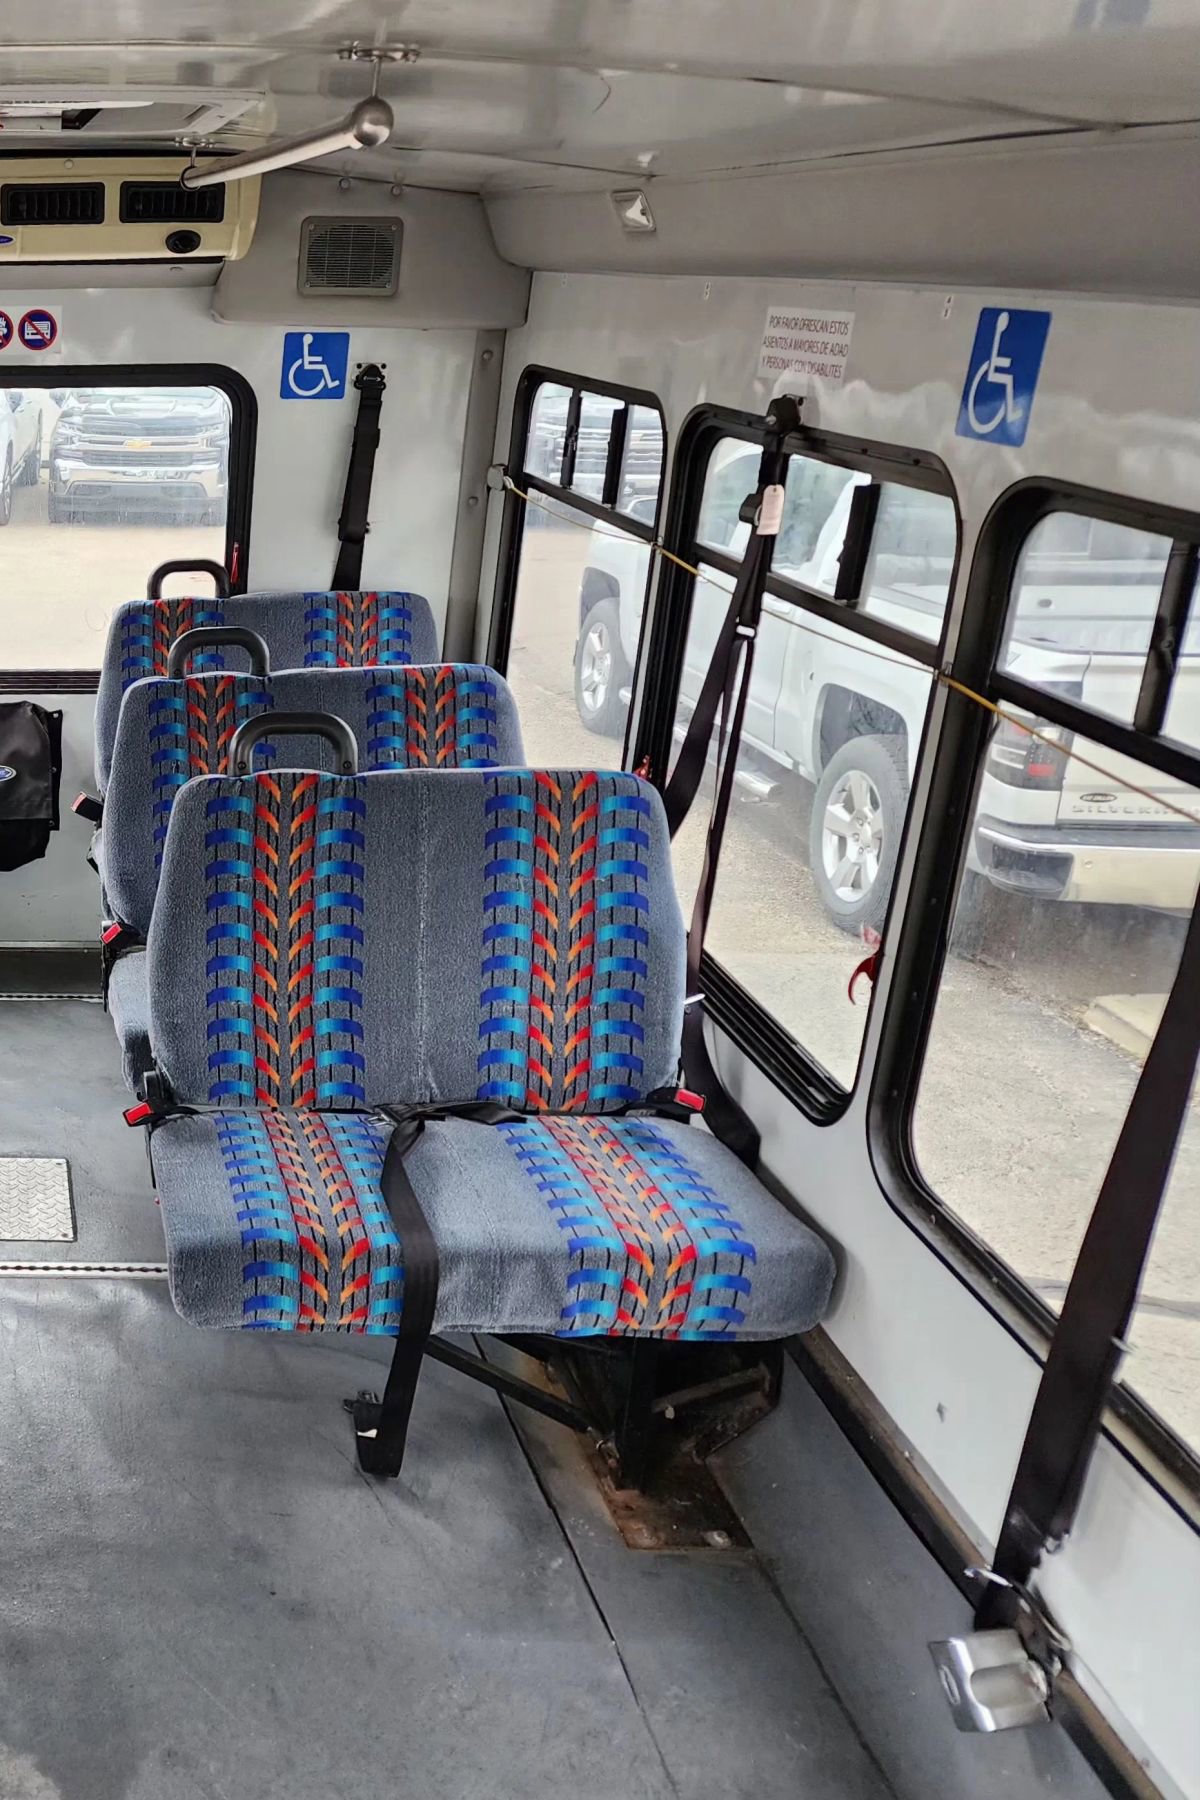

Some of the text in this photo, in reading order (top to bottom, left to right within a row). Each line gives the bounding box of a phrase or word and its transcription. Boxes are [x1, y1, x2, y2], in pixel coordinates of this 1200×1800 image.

[769, 315, 782, 329] POR
[782, 316, 799, 330] FAVOR
[829, 320, 850, 335] ESTOS
[762, 336, 789, 350] ASIENTOS
[794, 339, 819, 353] MAYORES
[819, 342, 829, 355] DE
[766, 356, 793, 370] PERSONAS
[793, 360, 807, 373] CON
